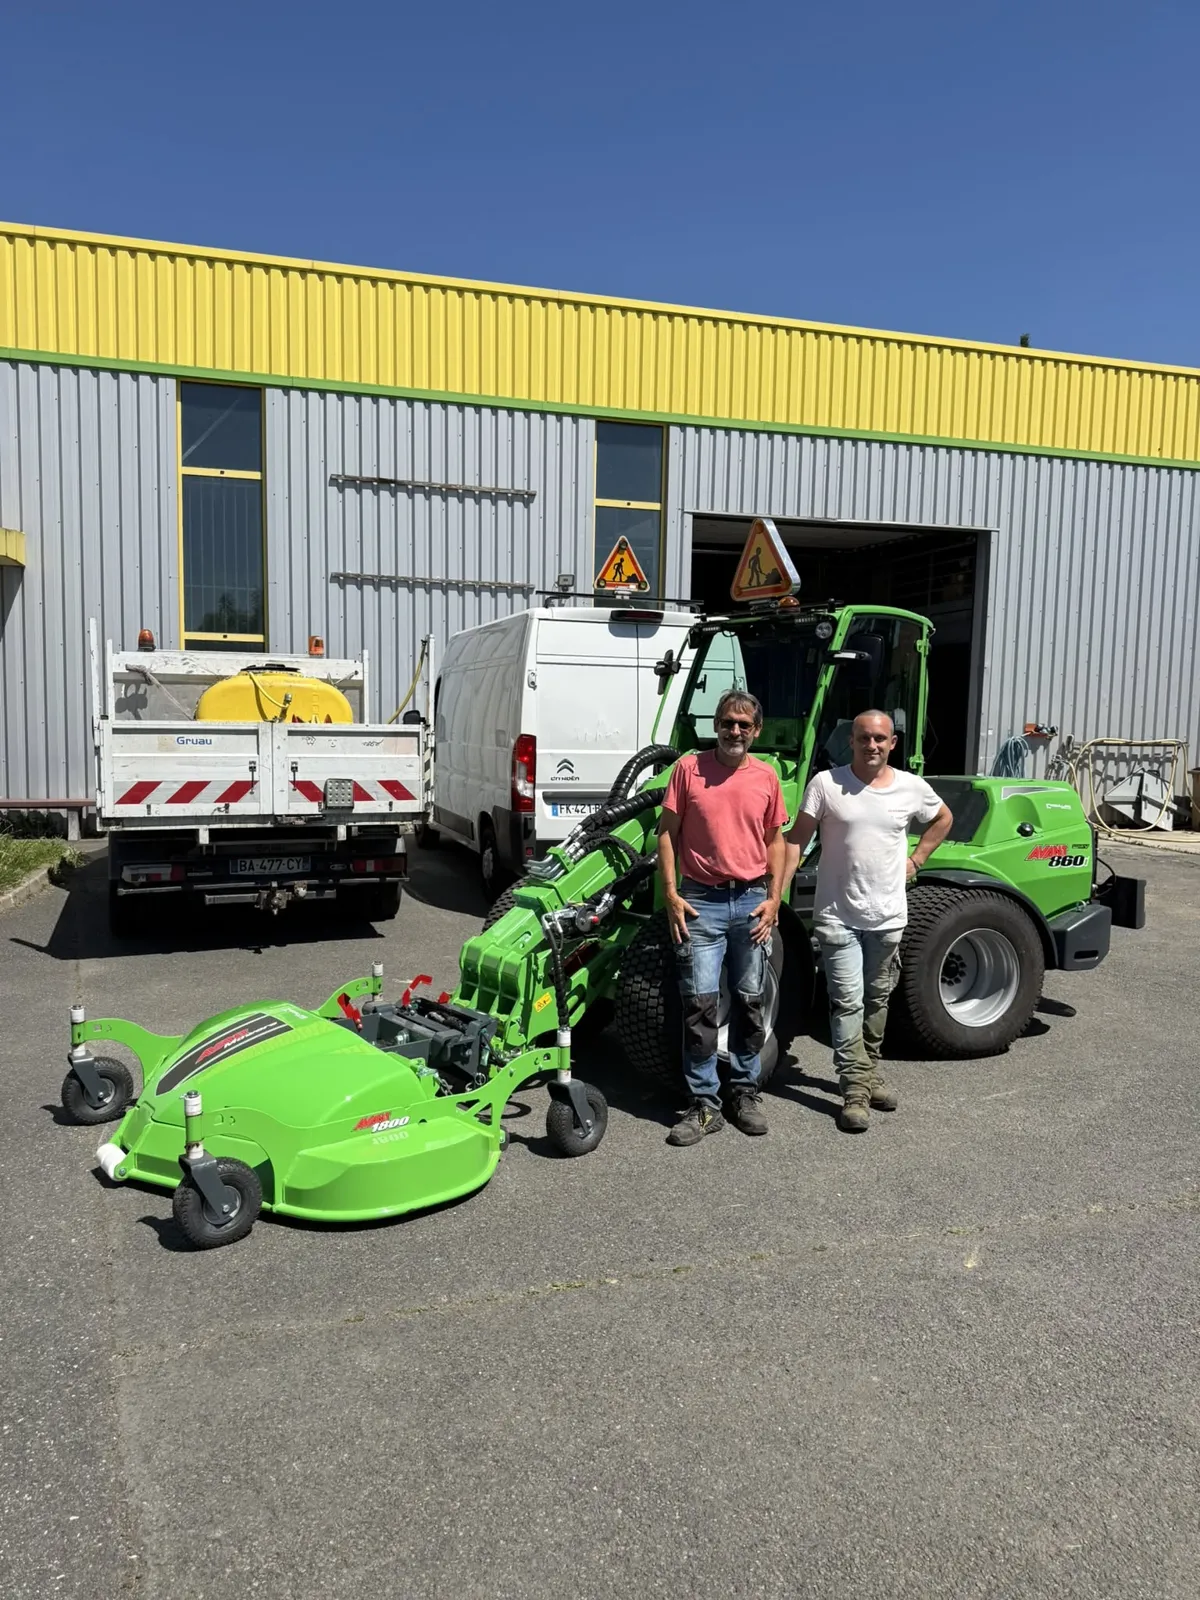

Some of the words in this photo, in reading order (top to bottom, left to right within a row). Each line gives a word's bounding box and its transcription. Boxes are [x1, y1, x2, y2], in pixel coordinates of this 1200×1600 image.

[176, 736, 212, 745] Gruau
[239, 857, 302, 872] BA-477-CY
[371, 1115, 410, 1133] 1800
